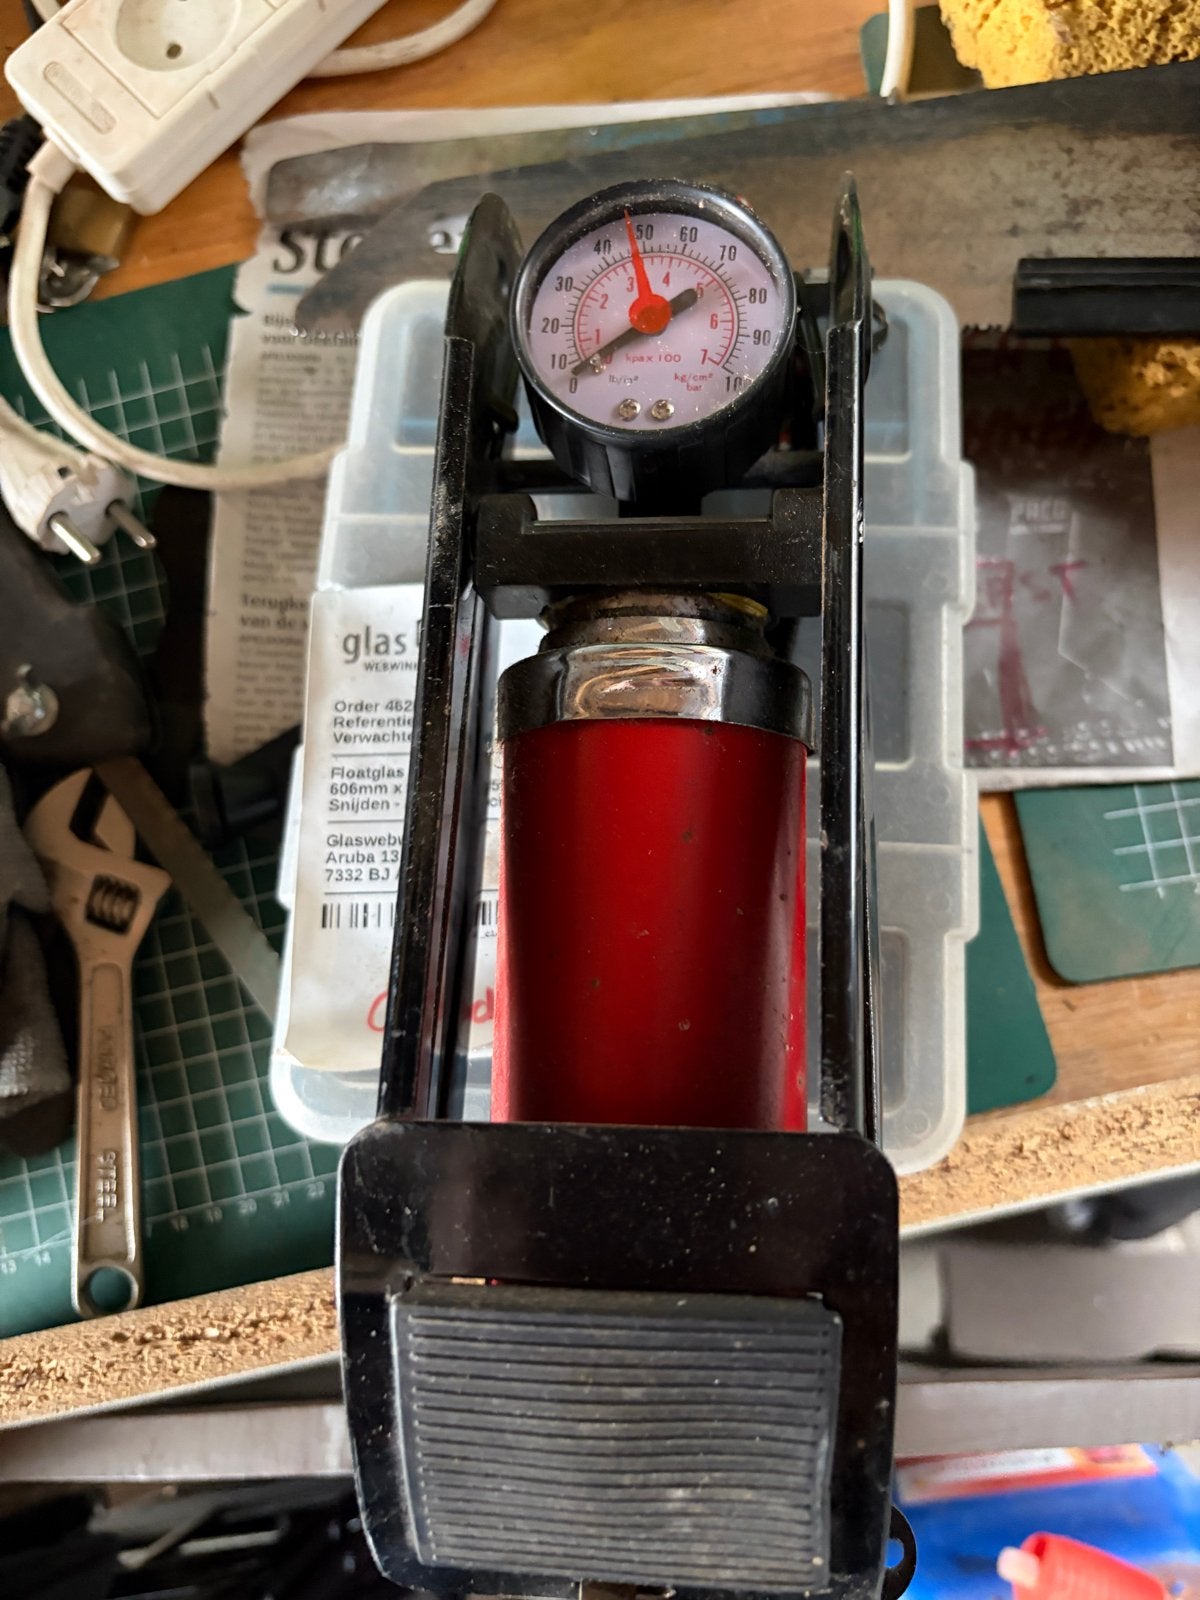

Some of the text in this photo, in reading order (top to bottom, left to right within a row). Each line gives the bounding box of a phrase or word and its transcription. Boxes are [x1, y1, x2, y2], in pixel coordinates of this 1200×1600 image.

[635, 224, 654, 241] 50
[679, 226, 699, 244] 60
[593, 239, 612, 256] 40
[719, 245, 737, 262] 70
[555, 275, 574, 293] 30
[626, 276, 635, 293] 3
[662, 271, 671, 288] 4
[599, 293, 609, 310] 2
[749, 288, 768, 305] 80
[541, 317, 560, 335] 20
[709, 313, 719, 330] 6
[595, 328, 601, 345] 1
[752, 329, 772, 346] 90
[550, 353, 568, 370] 10
[659, 353, 682, 363] 100
[701, 348, 709, 365] 7
[568, 377, 578, 394] 0
[342, 625, 408, 664] glas
[334, 700, 380, 713] Order
[330, 765, 405, 781] Floatglas
[330, 782, 403, 795] 606mm x
[328, 798, 391, 813] Snijden
[326, 833, 403, 847] Glasweb
[325, 850, 376, 863] Aruba
[324, 868, 364, 881] 7332
[368, 867, 391, 881] BJ
